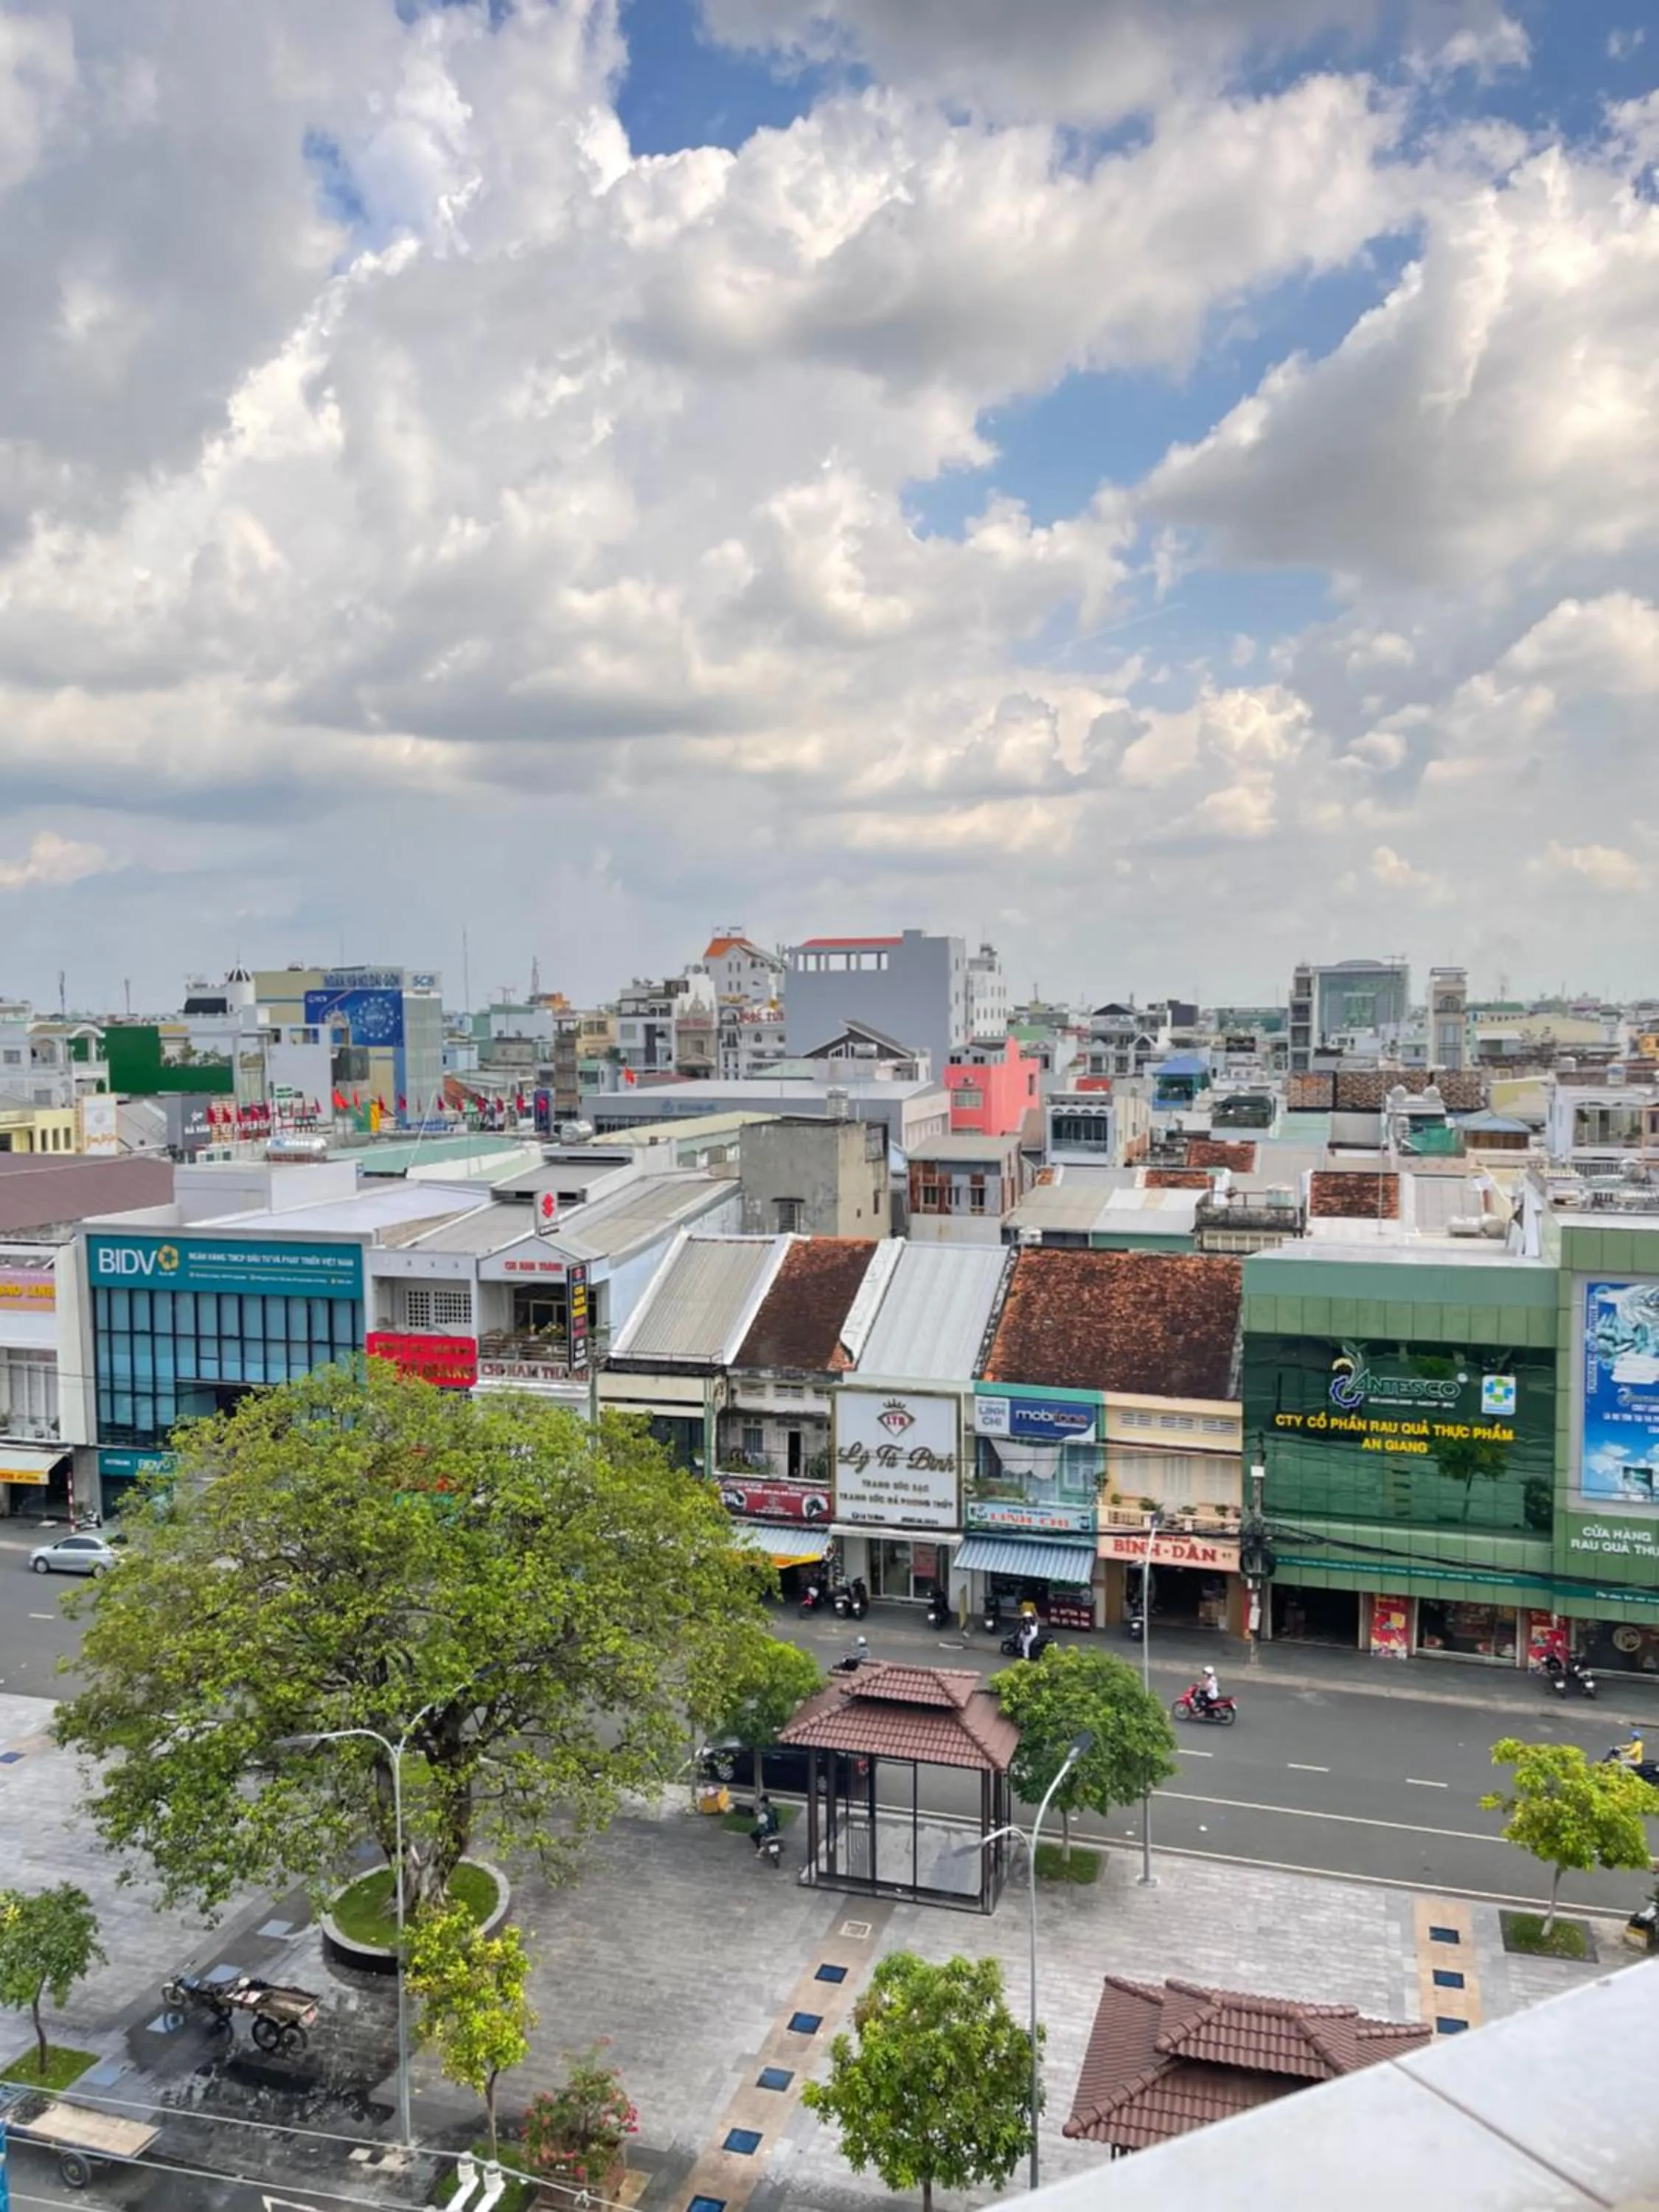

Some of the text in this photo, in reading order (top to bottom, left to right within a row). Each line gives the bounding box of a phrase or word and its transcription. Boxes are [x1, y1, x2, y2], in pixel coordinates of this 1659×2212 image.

[413, 975, 435, 987] SCB
[98, 1248, 158, 1276] BIDV
[1350, 1369, 1461, 1399] ANTESCO
[1275, 1411, 1514, 1441] CTY CỔ PHẦN RAU QUẢ THỰC PHẨM
[1361, 1438, 1428, 1453] AN GIANG
[862, 1479, 890, 1489] TRANG
[839, 1492, 866, 1503] TRANG
[1582, 1524, 1652, 1543] CỬA HÀNG
[1571, 1538, 1599, 1551] RAU
[1601, 1540, 1630, 1554] QUẢ
